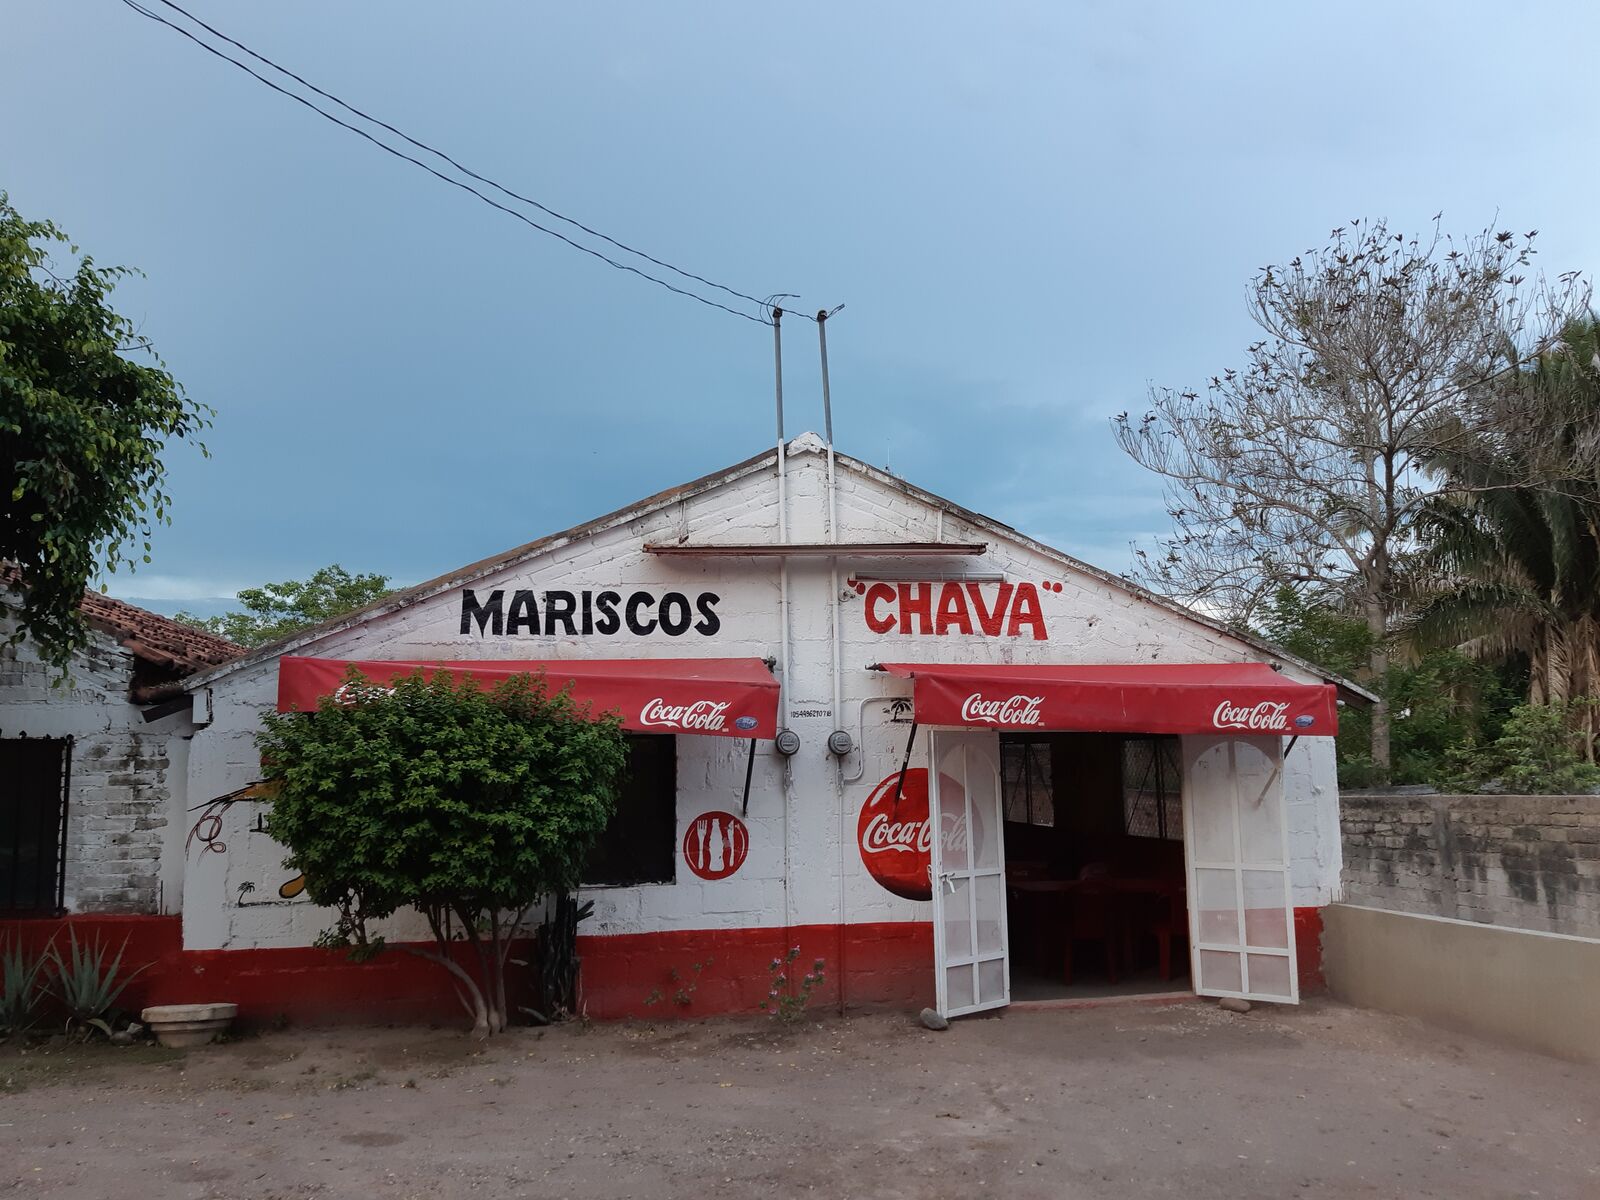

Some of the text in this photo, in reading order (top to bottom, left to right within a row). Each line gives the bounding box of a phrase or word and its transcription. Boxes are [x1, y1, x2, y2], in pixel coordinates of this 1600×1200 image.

[460, 589, 721, 639] MARISCOS
[640, 697, 732, 731] Coca-Cola
[961, 692, 1046, 726] Coca-Cola
[1213, 700, 1291, 730] Coca-Cola
